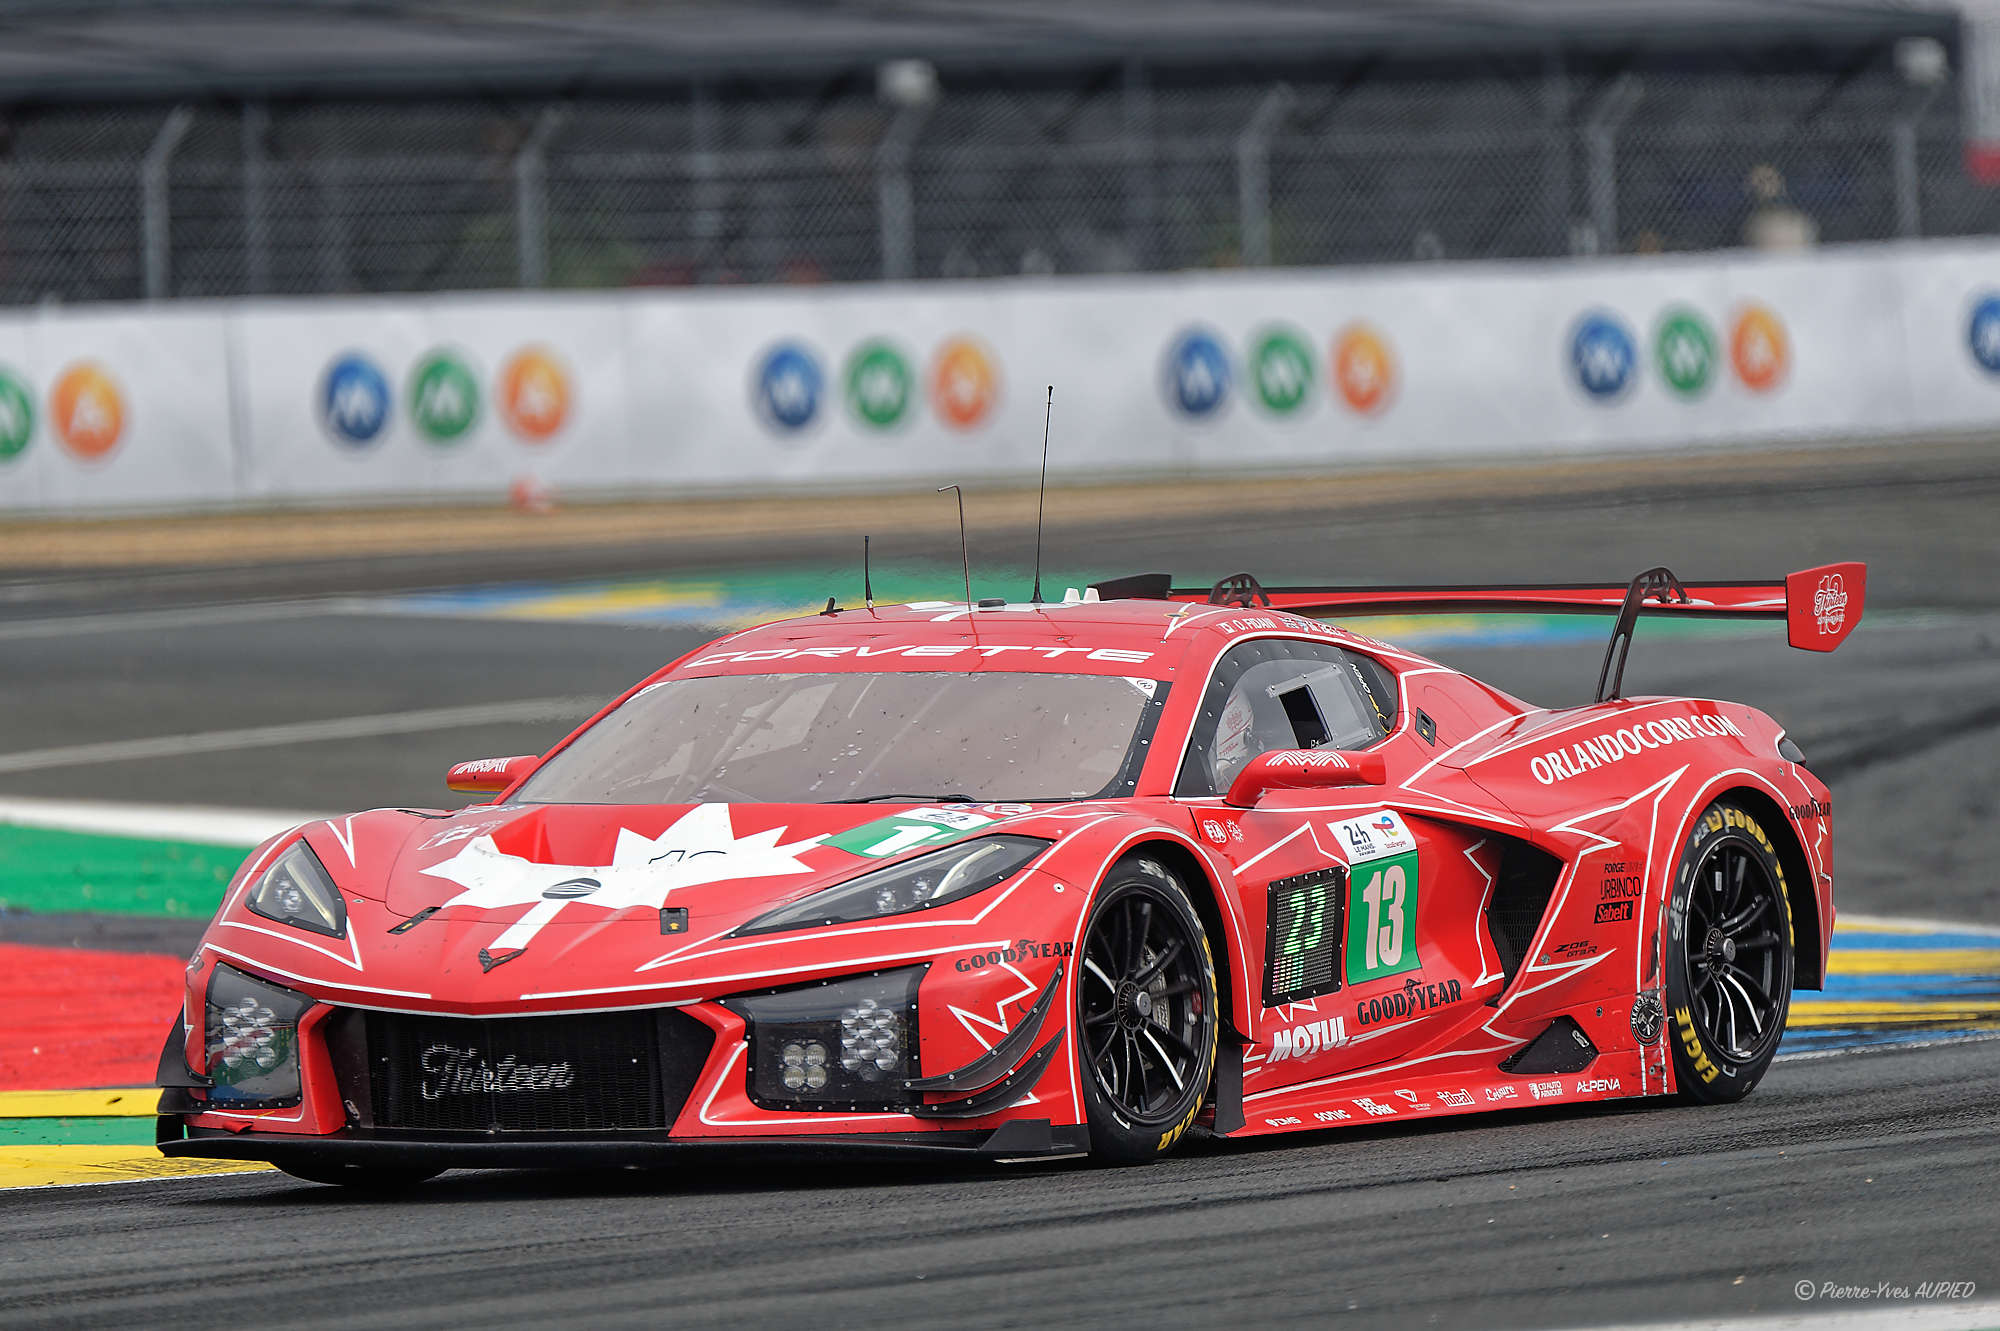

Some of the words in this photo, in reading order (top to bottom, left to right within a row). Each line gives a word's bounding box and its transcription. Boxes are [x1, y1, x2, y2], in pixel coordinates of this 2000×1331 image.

[684, 645, 1155, 668] CORVETTE
[1531, 715, 1745, 784] ORLANDOCORP.COM
[1363, 865, 1406, 970] 13
[1597, 903, 1629, 921] Sabelt
[956, 940, 1073, 972] GOODYEAR
[1357, 979, 1462, 1025] GOODYEAR
[1267, 1016, 1350, 1062] MOTUL
[1675, 1006, 1720, 1085] EAGLE
[1576, 1078, 1621, 1093] ALPENA
